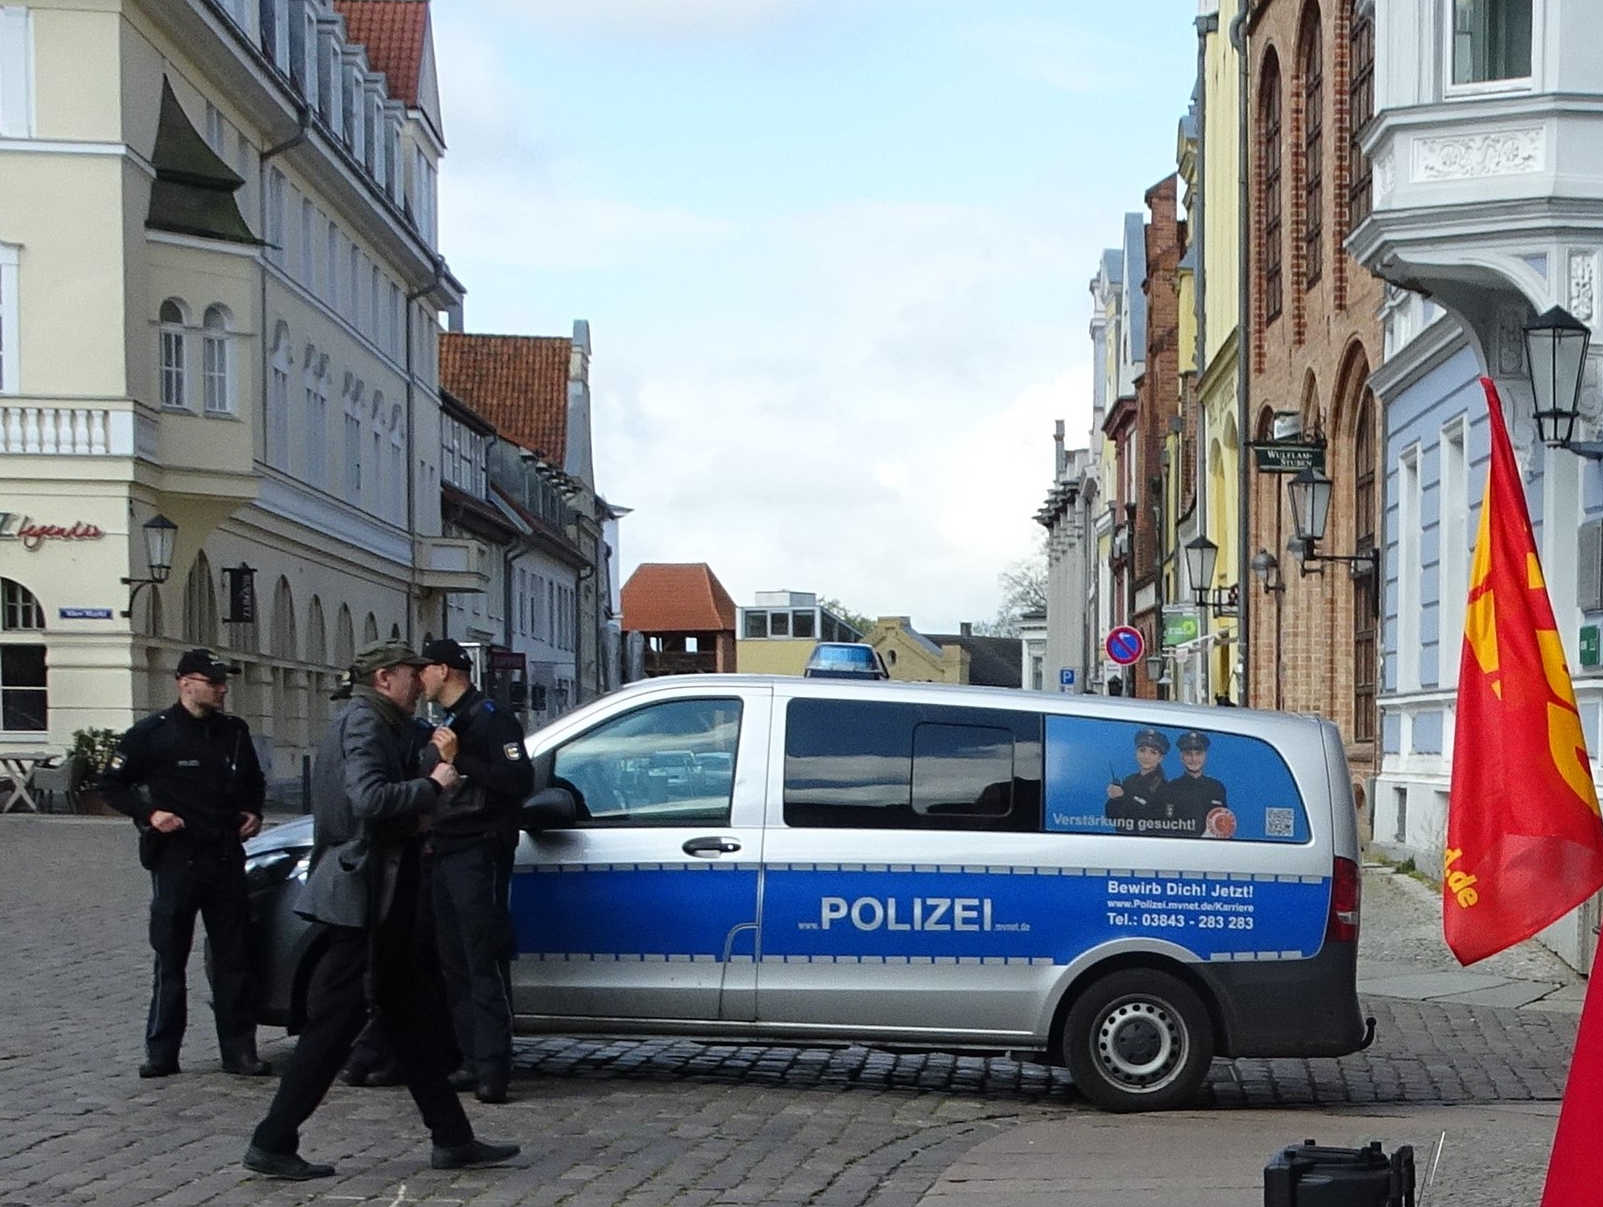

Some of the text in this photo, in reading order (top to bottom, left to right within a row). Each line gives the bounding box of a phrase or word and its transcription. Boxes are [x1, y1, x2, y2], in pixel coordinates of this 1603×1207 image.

[1052, 812, 1195, 832] Verstärkung gesucht!
[1108, 880, 1253, 898] Bewirb Dich! Jetzt!
[1107, 912, 1138, 926] Tel.:
[1142, 914, 1185, 927] 03843
[1198, 915, 1224, 928] 283
[1228, 916, 1254, 930] 283
